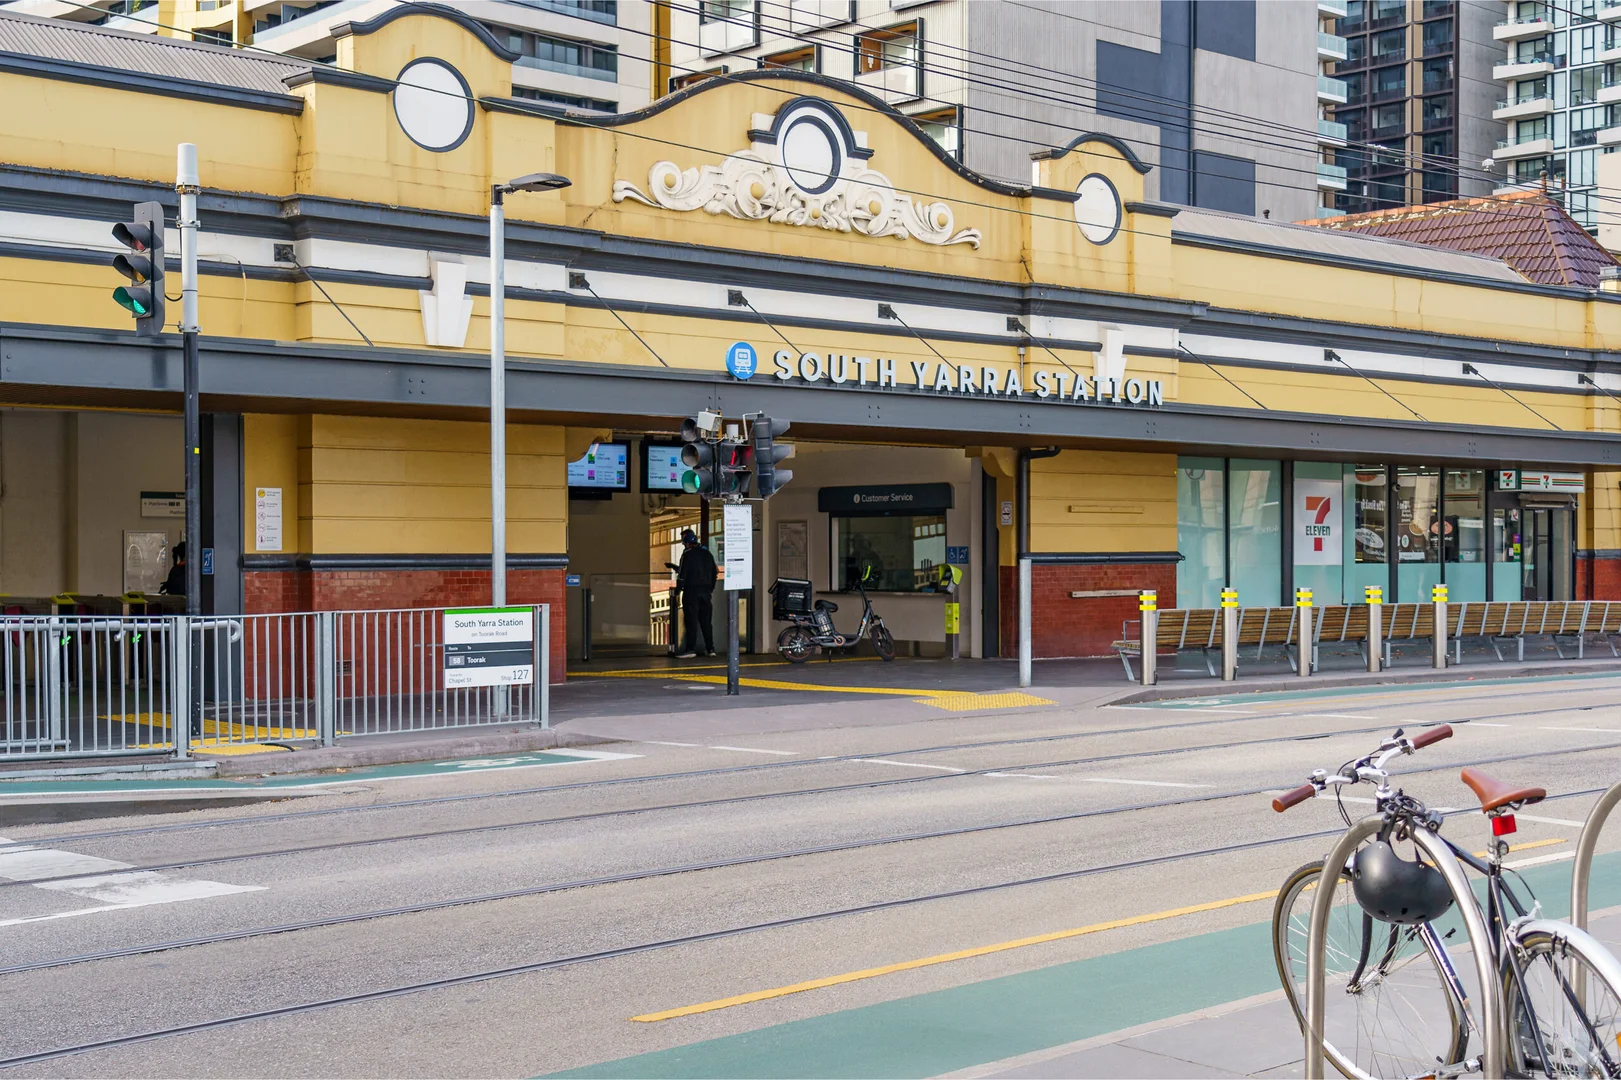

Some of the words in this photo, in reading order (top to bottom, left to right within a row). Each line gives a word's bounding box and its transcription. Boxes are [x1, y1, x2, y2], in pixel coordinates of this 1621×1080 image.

[773, 350, 897, 387] SOUTH
[911, 361, 1023, 396] YARRA
[1033, 370, 1163, 406] STATION
[861, 494, 889, 502] Customer
[891, 493, 913, 501] Service
[454, 620, 476, 628] South
[477, 619, 496, 628] Yarra
[498, 618, 523, 627] Station
[512, 669, 529, 680] 127
